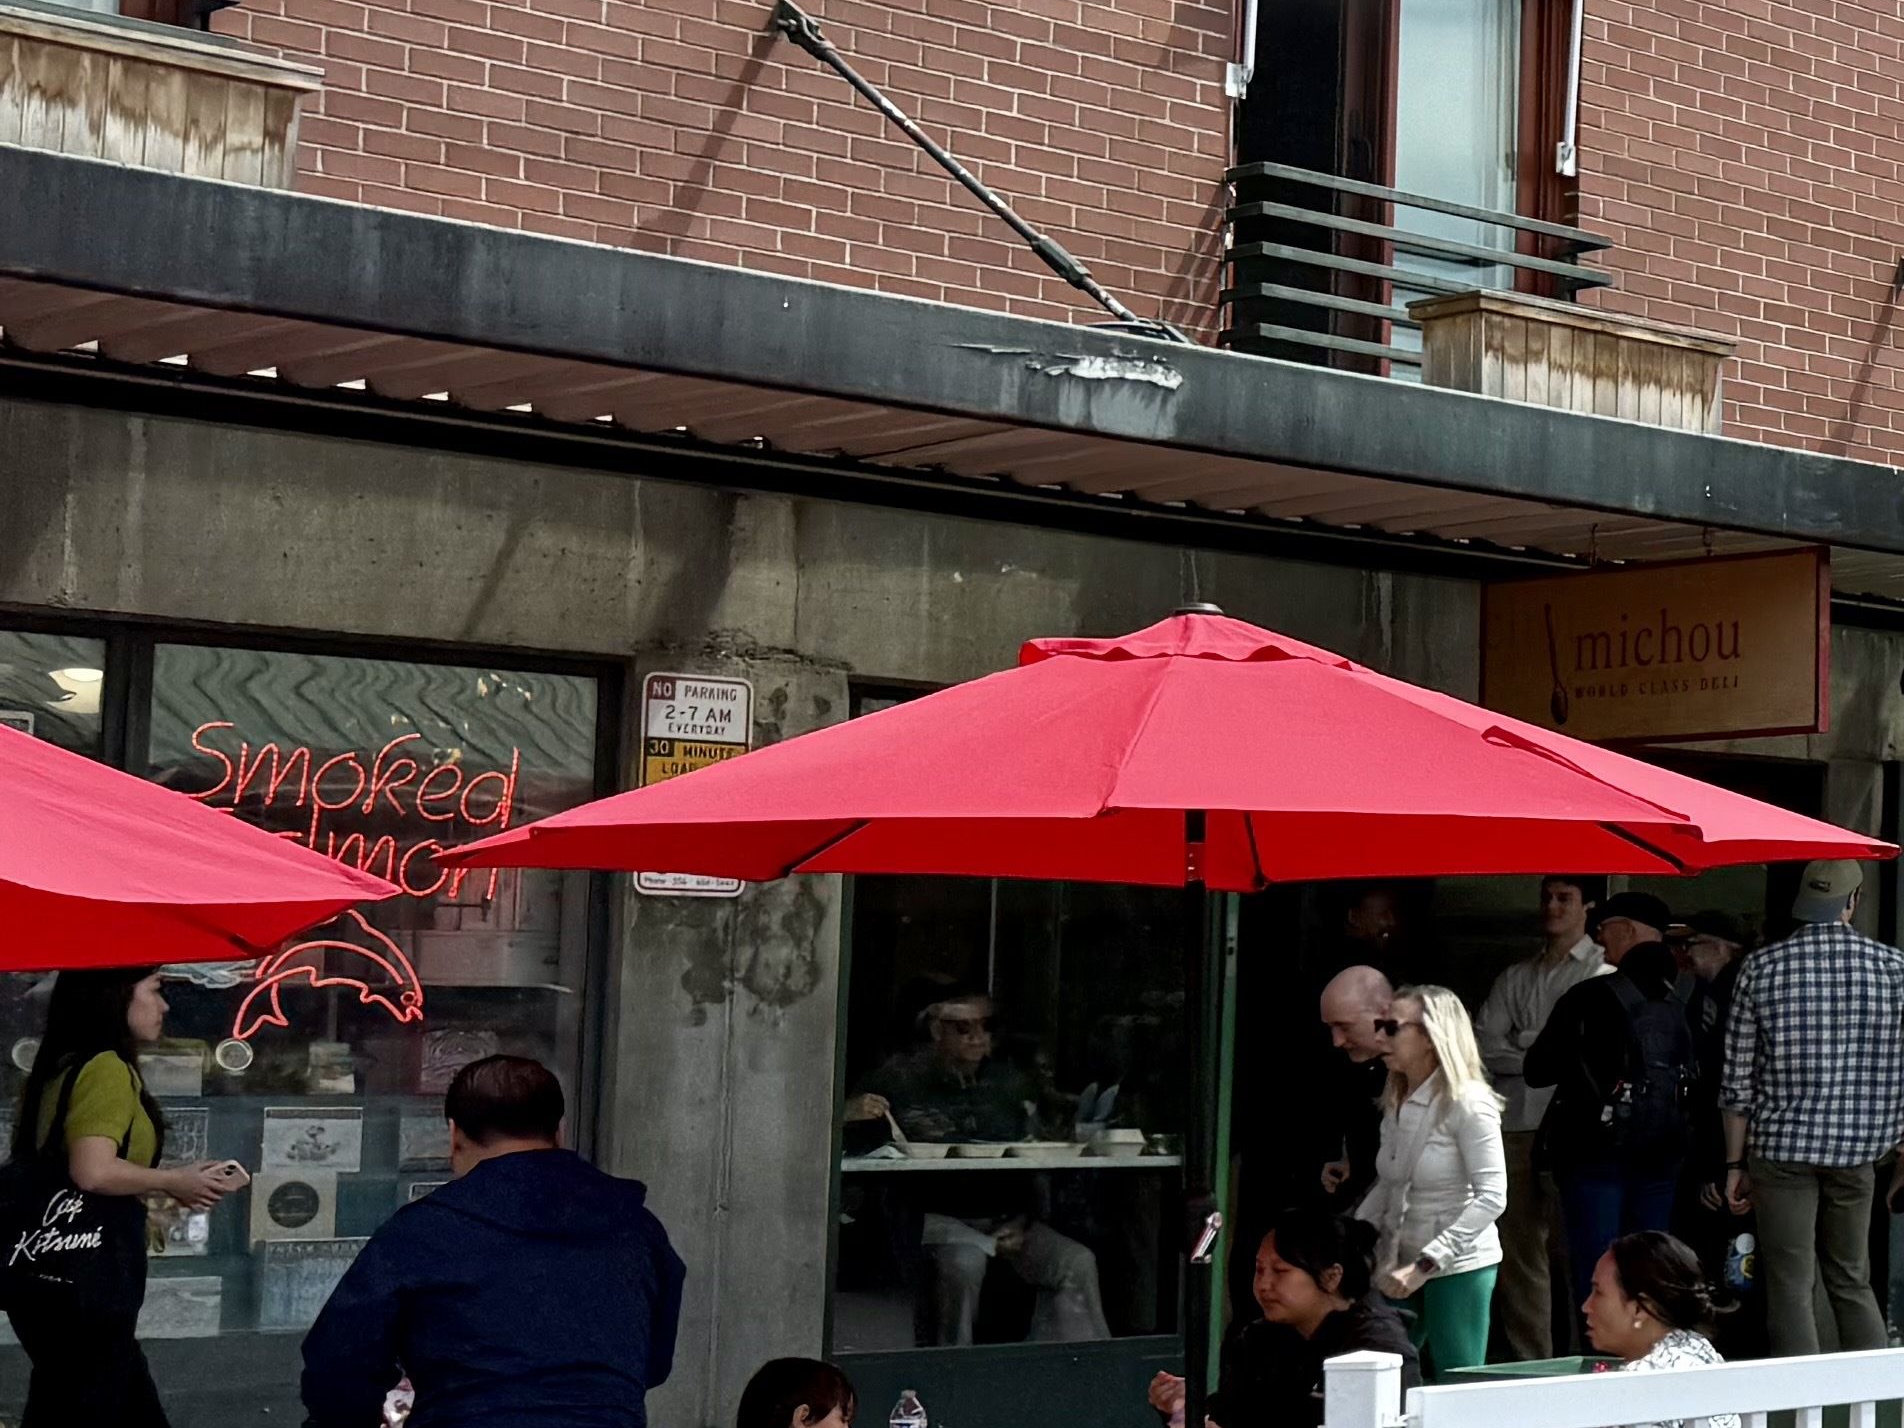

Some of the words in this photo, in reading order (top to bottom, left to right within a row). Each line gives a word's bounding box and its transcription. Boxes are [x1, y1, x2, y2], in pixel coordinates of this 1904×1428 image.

[1574, 607, 1741, 671] michou
[652, 681, 673, 697] NO
[684, 685, 738, 702] PARKING
[1575, 683, 1629, 699] WORLD
[1639, 678, 1690, 696] CLASS
[1700, 675, 1739, 690] DELI
[665, 705, 698, 720] 2-7
[705, 708, 732, 723] AM
[668, 723, 726, 736] EVERYDAY
[650, 741, 670, 755] 30
[189, 721, 521, 829] Smoked
